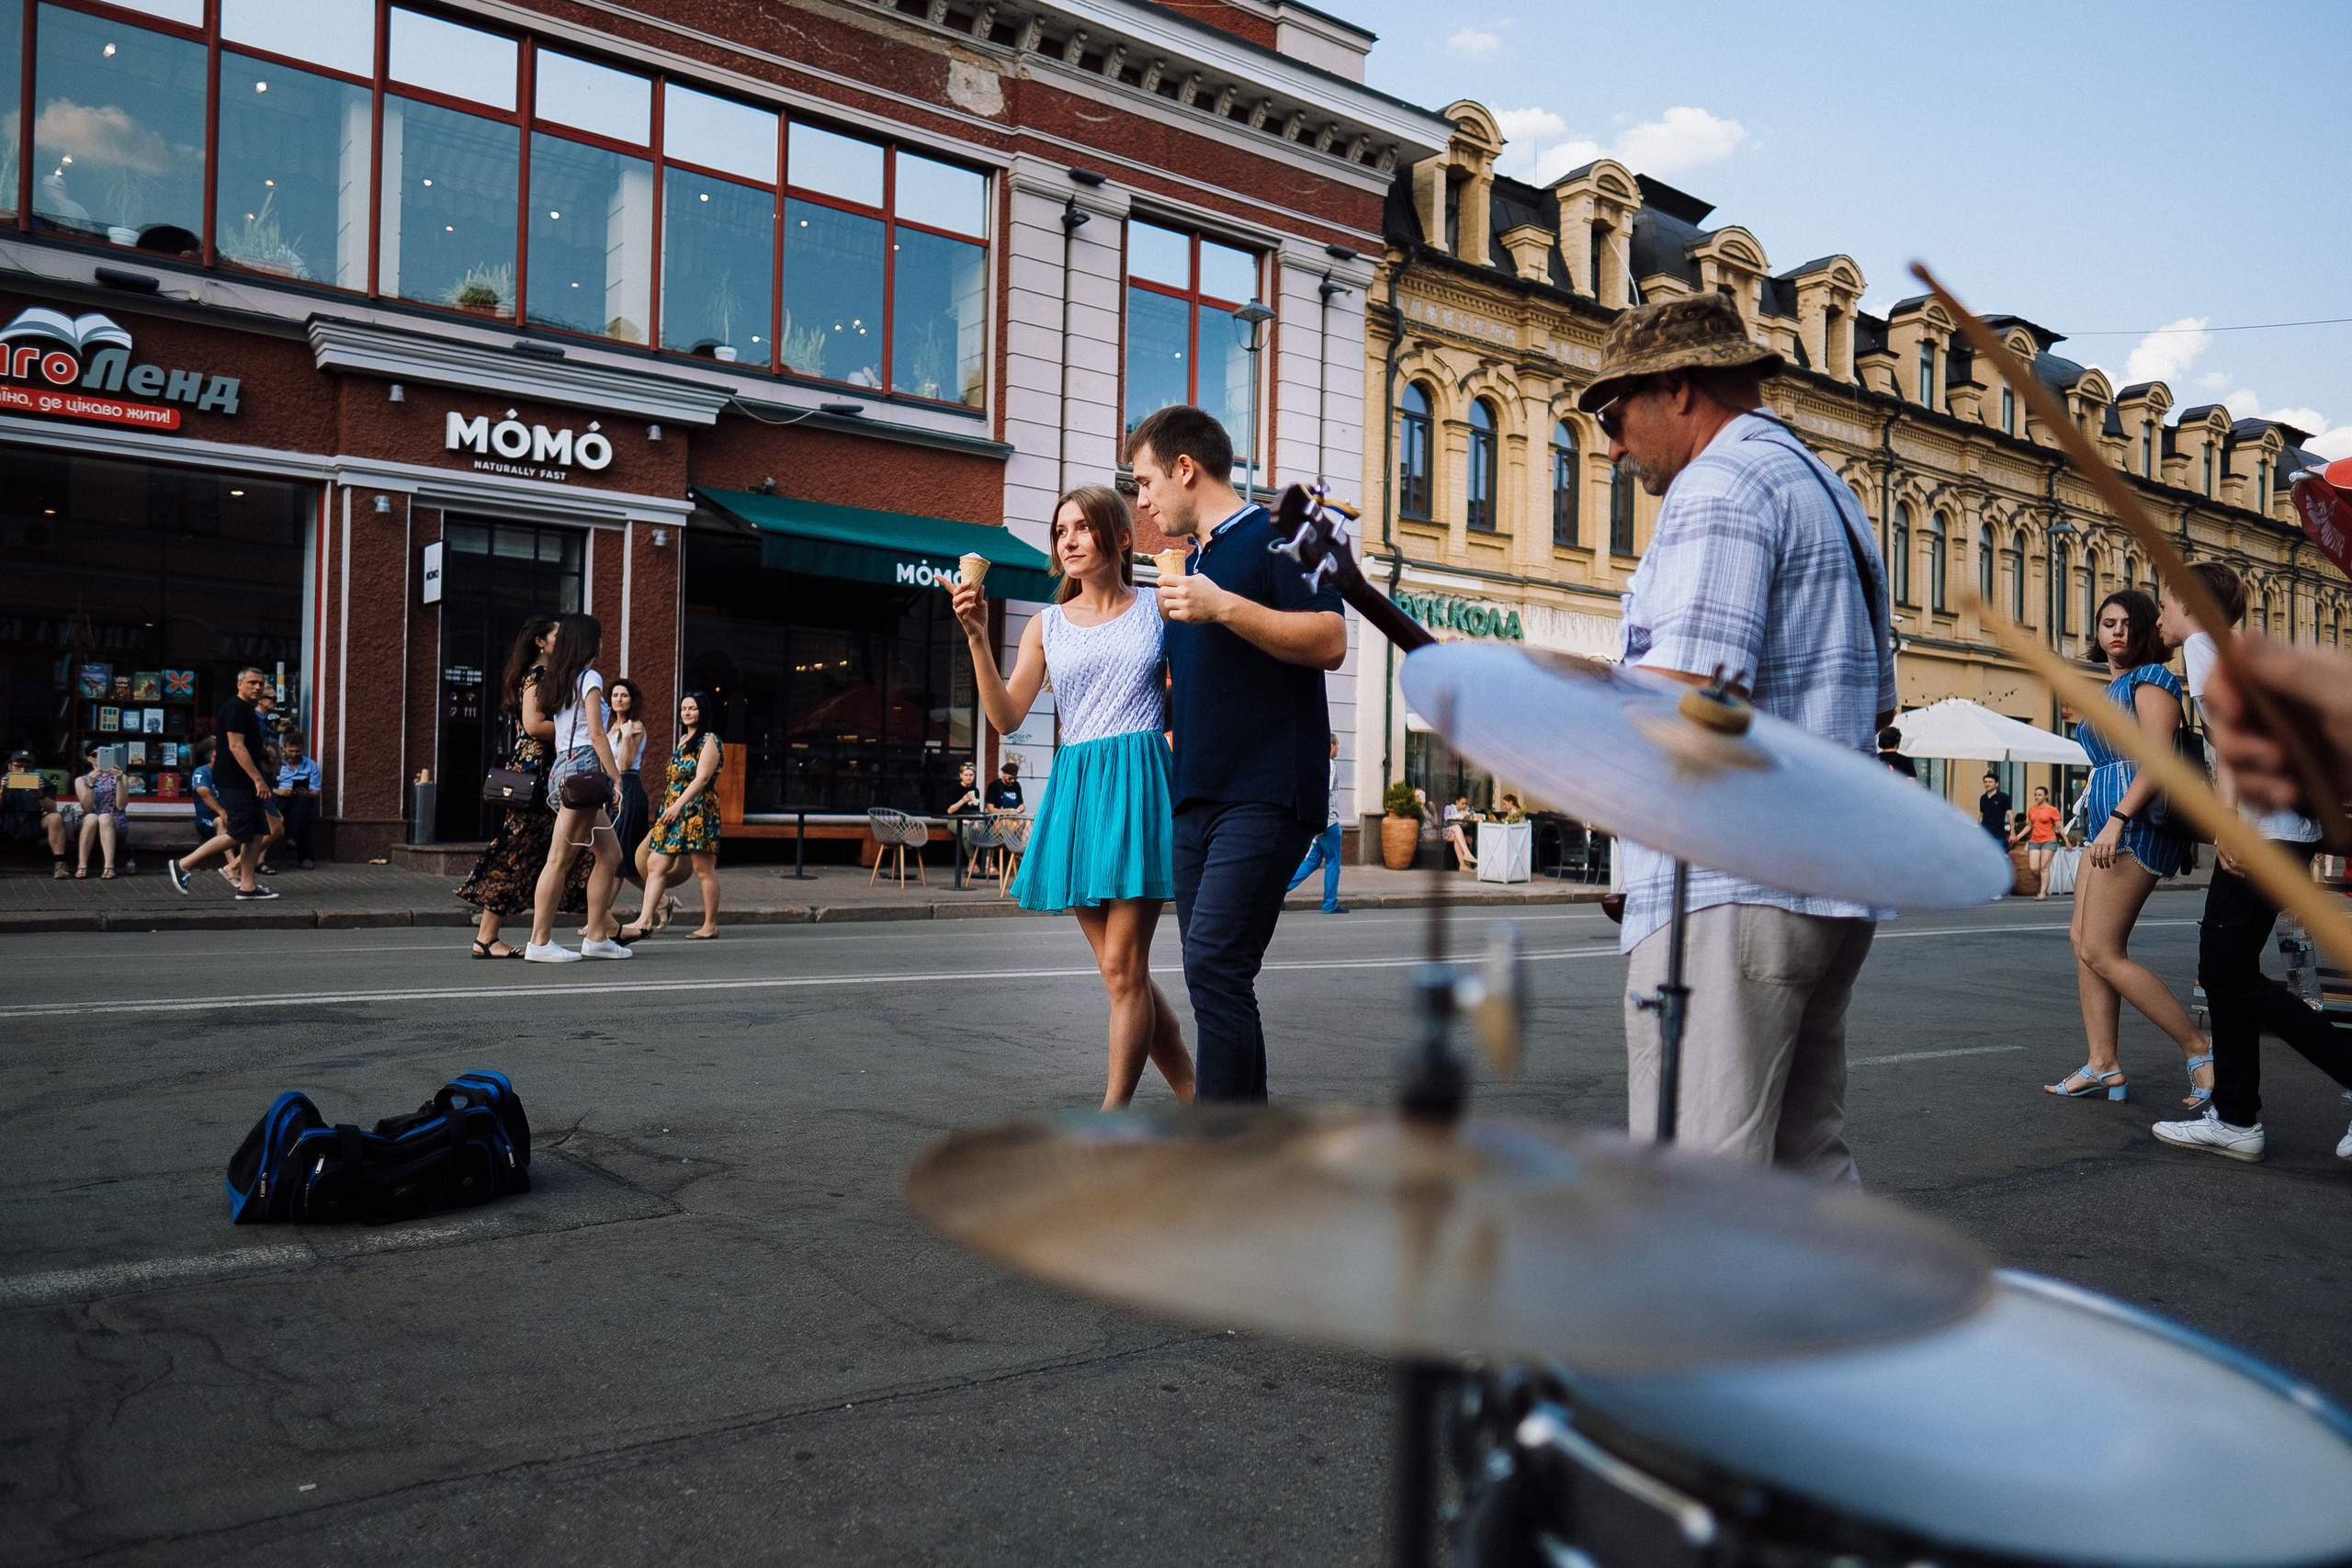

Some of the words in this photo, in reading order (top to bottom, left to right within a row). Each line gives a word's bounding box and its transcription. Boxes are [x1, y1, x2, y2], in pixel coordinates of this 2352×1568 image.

[0, 387, 33, 407] їна,
[39, 396, 62, 412] де
[66, 397, 123, 417] цікаво
[127, 408, 170, 423] жити!
[473, 460, 536, 477] NATURALLY
[540, 468, 567, 480] FAST
[1396, 593, 1525, 639] РУККОЛА
